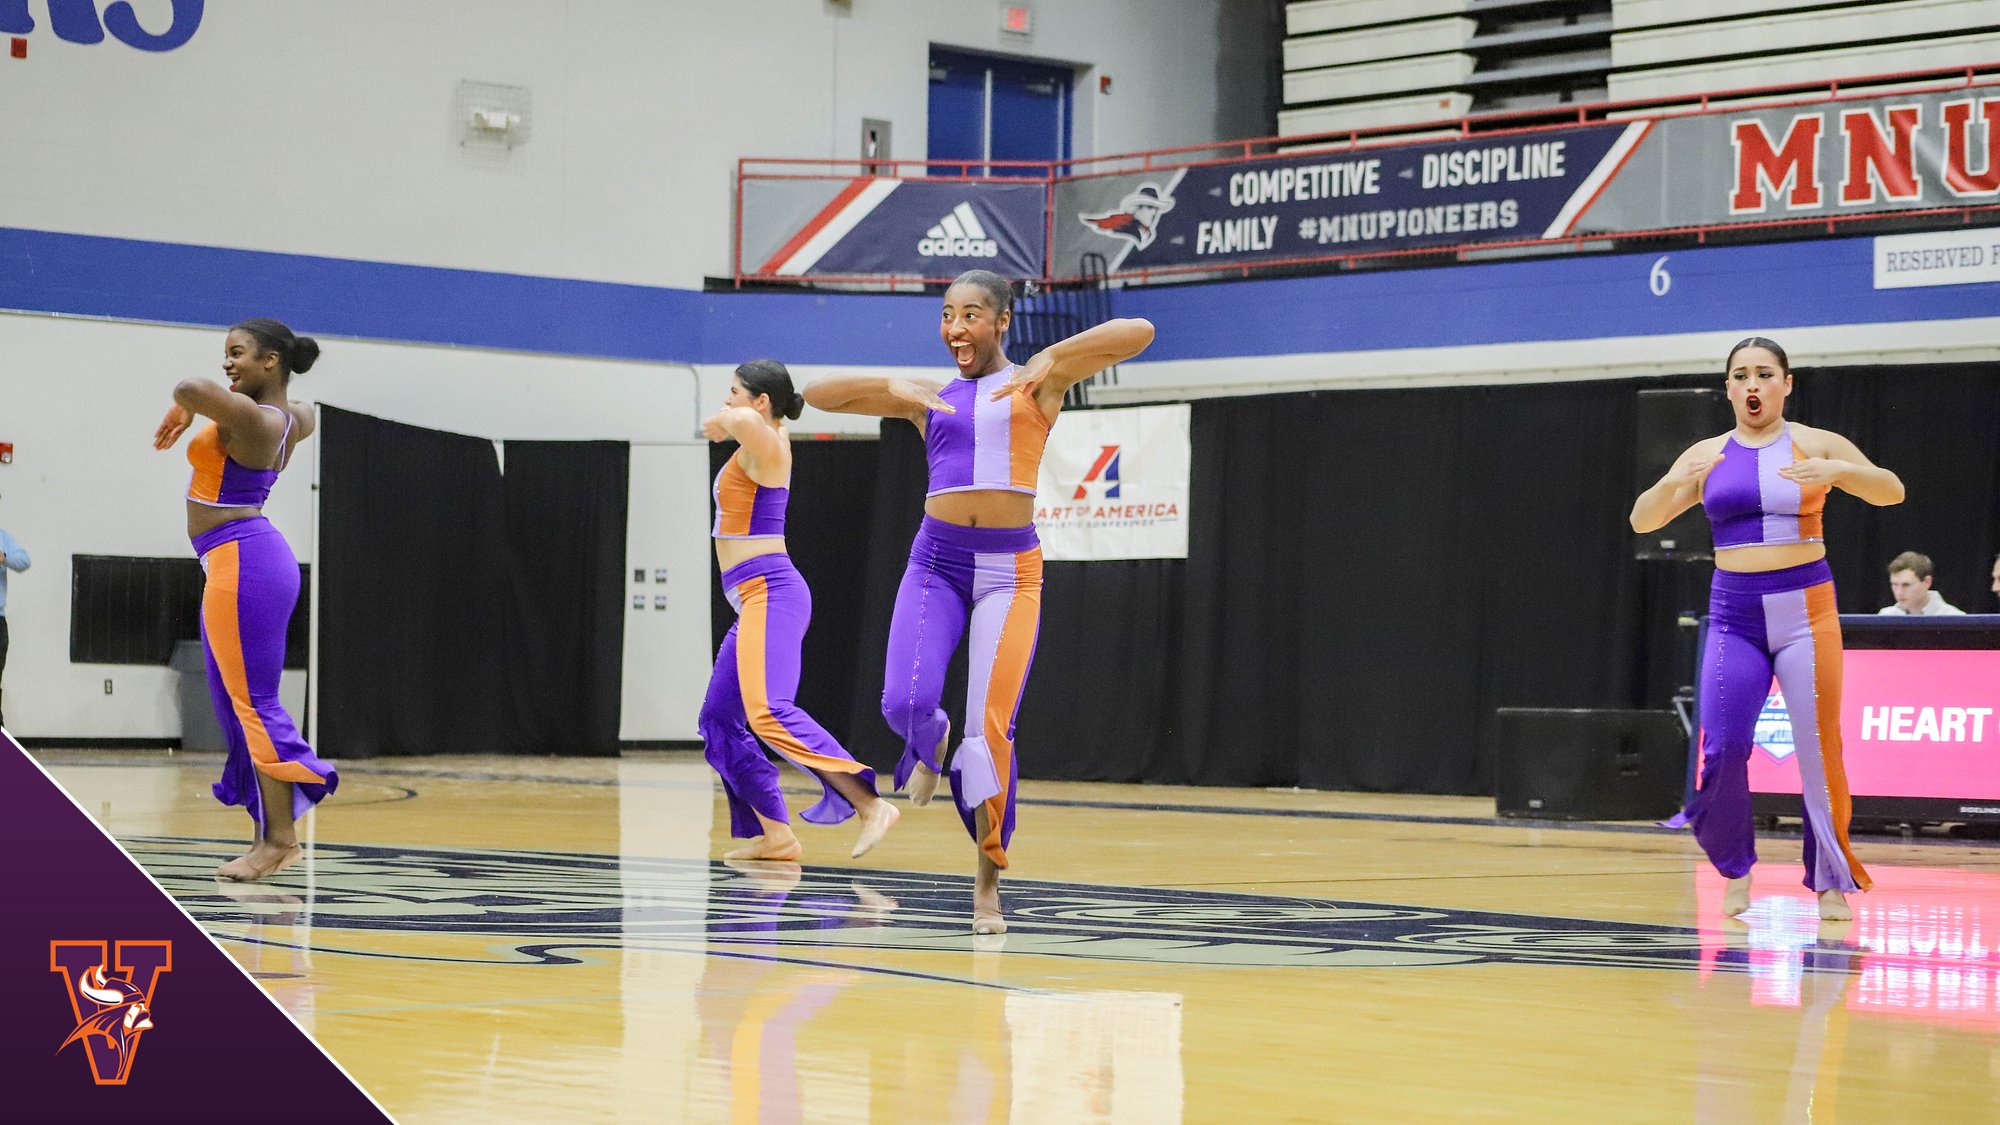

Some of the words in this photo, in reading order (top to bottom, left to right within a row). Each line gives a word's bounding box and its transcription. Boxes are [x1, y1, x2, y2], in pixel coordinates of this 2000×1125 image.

[1229, 159, 1381, 207] COMPETITIVE
[1422, 141, 1566, 189] DISCIPLINE
[1729, 97, 2000, 215] MNU
[1195, 215, 1278, 254] FAMILY
[1299, 199, 1519, 244] #MNUPIONEERS
[917, 237, 998, 258] adidas
[1886, 246, 1984, 272] RESERVED
[1650, 254, 1671, 297] 6
[1094, 502, 1179, 519] AMERICA
[1861, 706, 1993, 742] HEART
